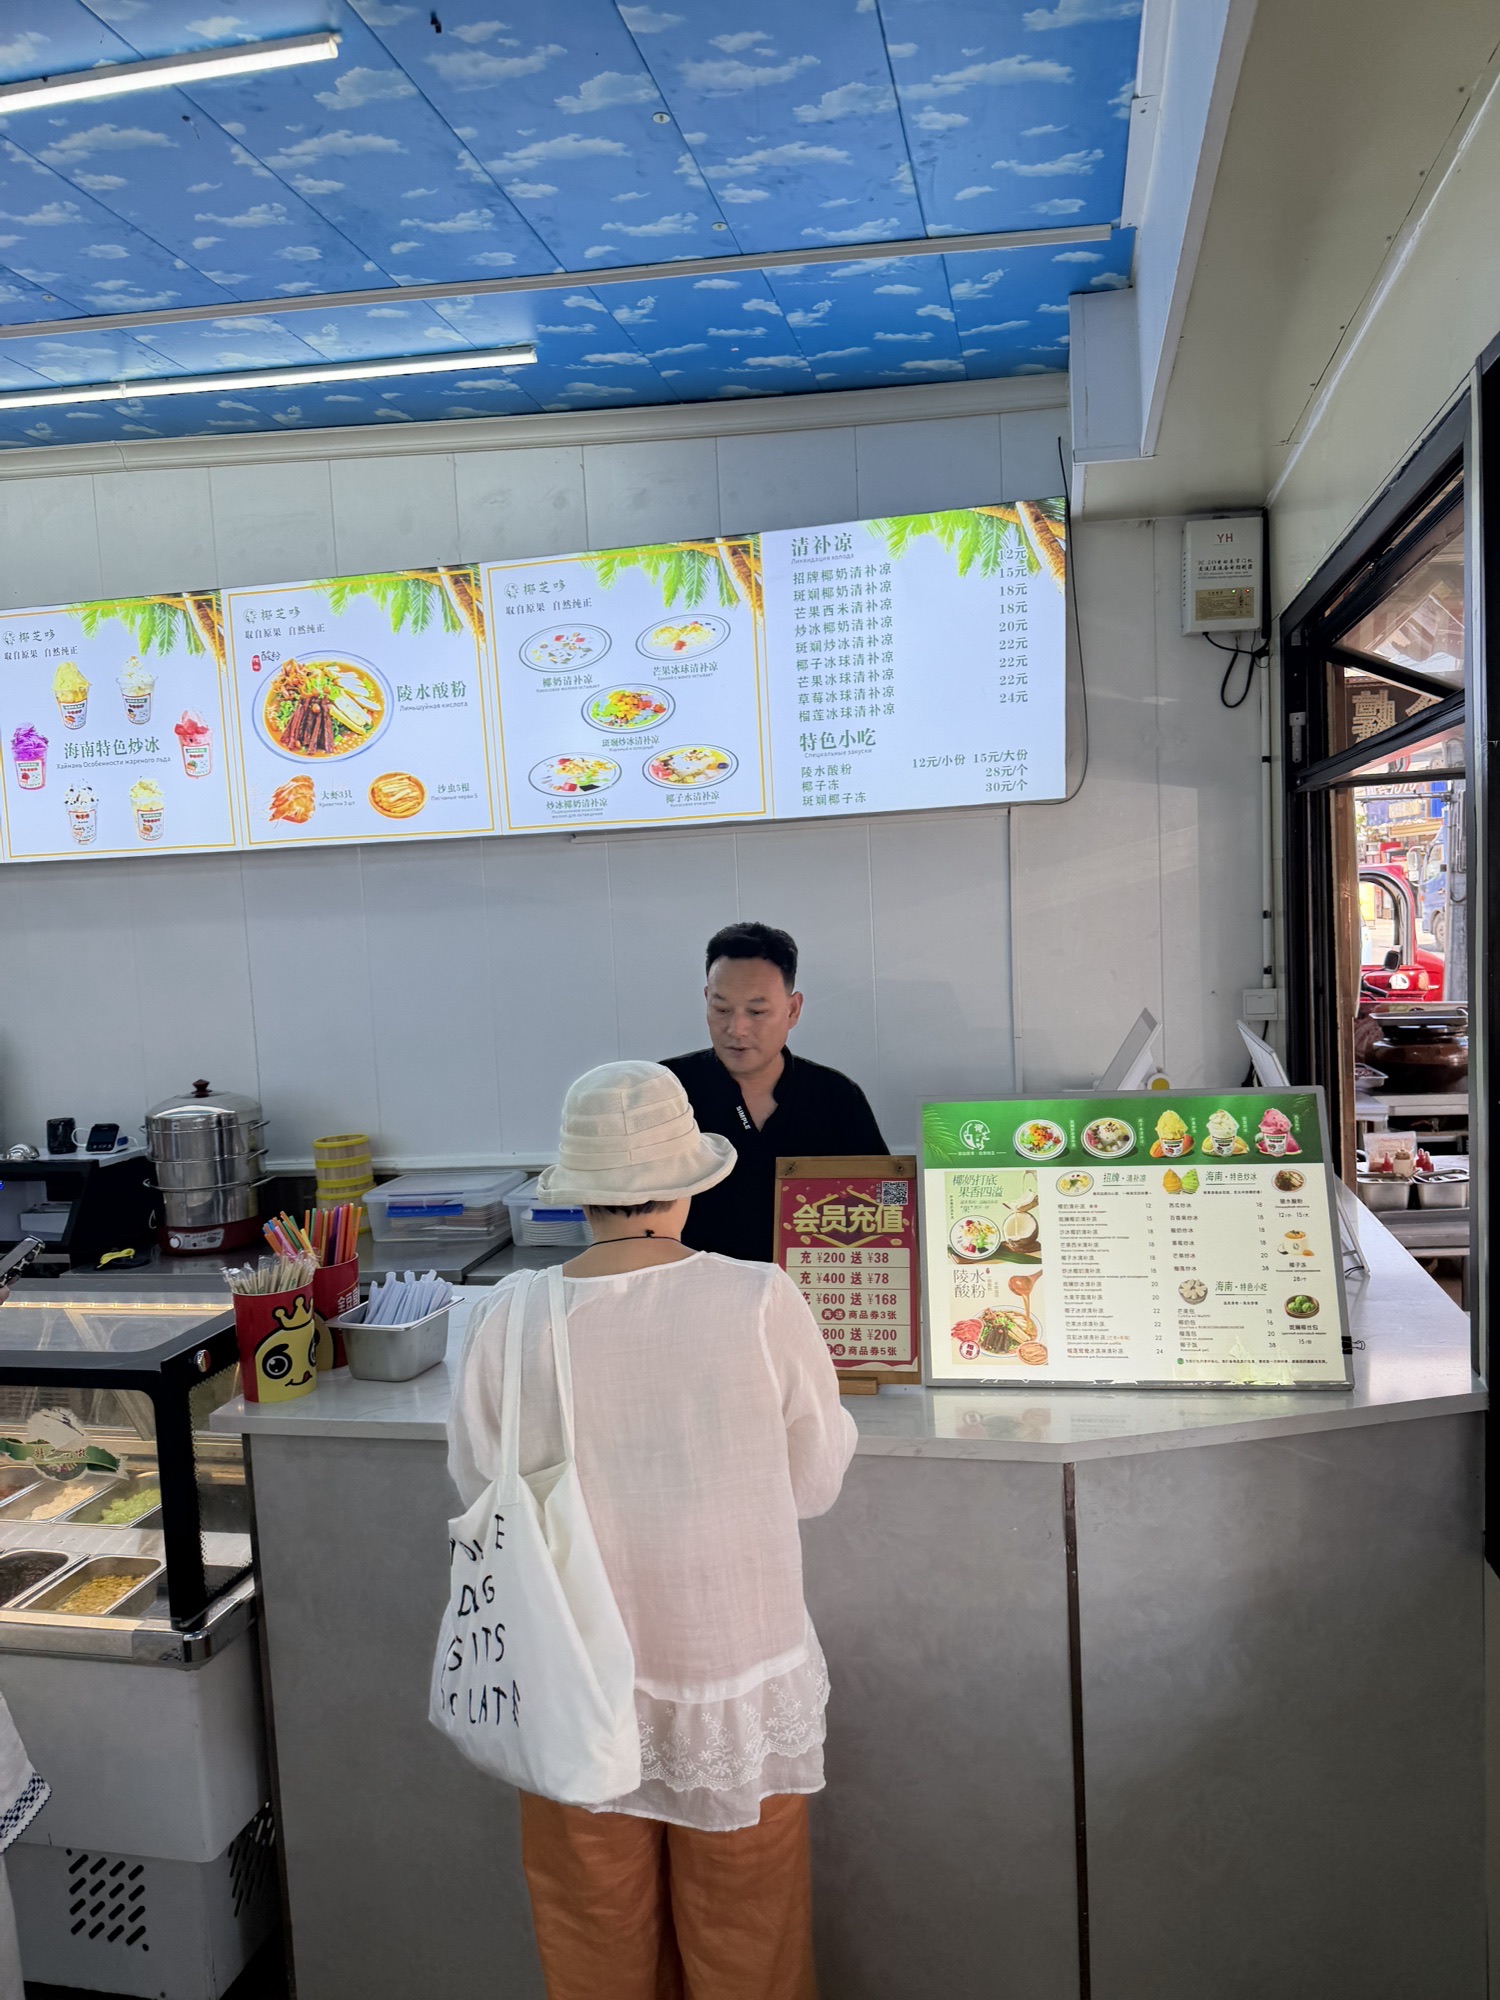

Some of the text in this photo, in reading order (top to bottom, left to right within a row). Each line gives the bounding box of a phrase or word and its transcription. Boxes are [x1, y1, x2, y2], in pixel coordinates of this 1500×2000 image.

[791, 533, 853, 557] 清补凉
[1217, 533, 1234, 543] YH
[793, 546, 1027, 585] 招牌椰奶清补凉 12元
[999, 564, 1028, 578] 15元
[505, 597, 592, 615] 取自原果 自然纯正
[794, 583, 1028, 620] 芒果西米清补凉 18元
[795, 601, 1028, 638] 炒冰椰奶清补凉 18元
[999, 619, 1028, 633] 20元
[245, 623, 325, 640] 取自原果 自然纯正
[4, 645, 78, 661] 取自原果 自然纯正
[796, 637, 1028, 672] 椰子冰球清补凉 22元
[797, 654, 1028, 688] 芒果冰球清补凉 22元
[396, 680, 467, 702] 陵水酸粉
[798, 672, 1028, 706] 草莓冰球清补凉 22元
[798, 690, 1028, 723] 榴莲冰球清补凉 24元
[64, 736, 160, 760] 海南特色炒冰
[799, 727, 876, 752] 特色小吃
[83, 758, 124, 768] Особенности
[801, 749, 1028, 778] 陵水酸粉 12元/小份 15元/大份
[801, 763, 1028, 792] 椰子冻 28元/个
[985, 778, 1028, 793] 30元/个
[735, 1105, 752, 1130] SIMPLE
[953, 1174, 998, 1186] 椰奶打底
[958, 1186, 1004, 1198] 果香四溢
[792, 1203, 904, 1234] 会员充值
[800, 1251, 889, 1264] 充 ¥200 送 ¥38
[800, 1271, 889, 1285] 充 ¥400 送 ¥78
[953, 1268, 986, 1284] 陵水
[816, 1293, 846, 1305] ¥600
[850, 1292, 862, 1306] 送
[867, 1293, 896, 1305] ¥168
[954, 1283, 986, 1298] 酸粉
[821, 1308, 897, 1320] 再送 商品券3张
[819, 1328, 897, 1341] 800 送 ¥200
[848, 1346, 898, 1356] 商品券5张
